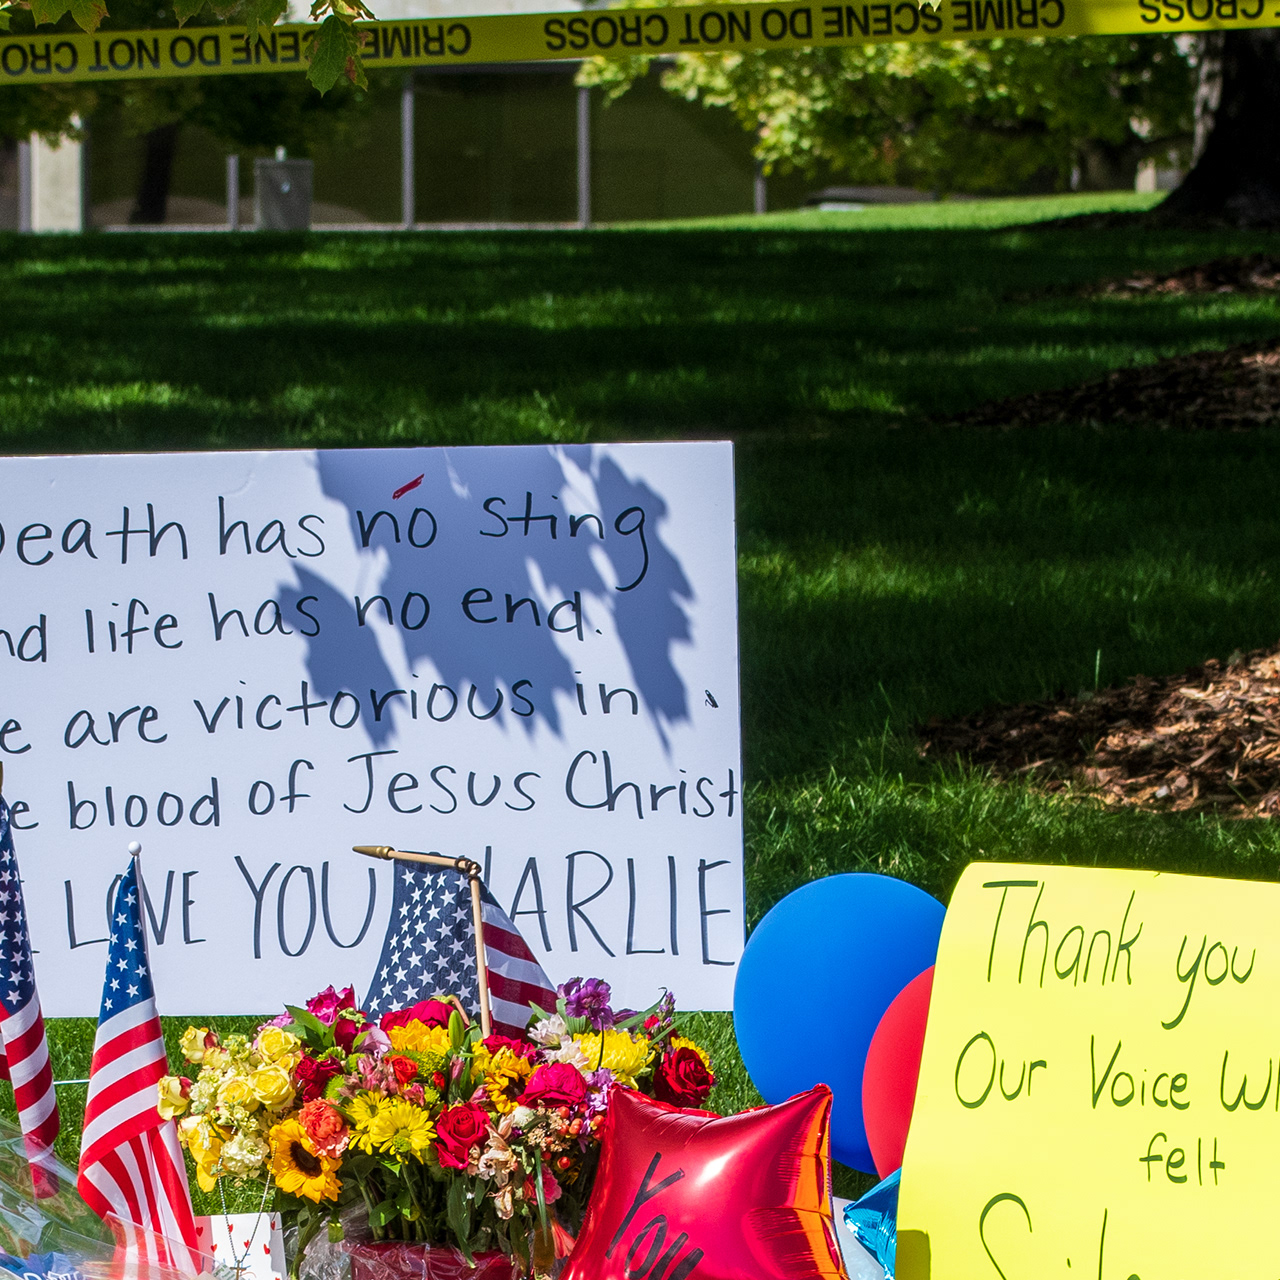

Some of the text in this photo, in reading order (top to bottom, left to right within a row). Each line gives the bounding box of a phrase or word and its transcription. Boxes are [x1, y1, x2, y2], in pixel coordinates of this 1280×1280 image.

[88, 38, 161, 71] NOT
[170, 35, 221, 68] DO
[360, 23, 472, 59] CRIME
[544, 0, 1065, 50] CRIME SCENE DO NOT CROSS
[219, 495, 325, 560] has
[357, 503, 437, 550] no
[478, 491, 648, 592] sting
[86, 598, 184, 656] life
[212, 592, 320, 642] has
[355, 587, 431, 631] no
[461, 586, 603, 642] end.
[63, 705, 168, 749] are
[193, 671, 535, 735] victorious
[575, 670, 639, 718] in
[69, 775, 221, 830] blood
[248, 758, 315, 815] of
[342, 748, 541, 816] Jesus
[565, 748, 738, 820] Christ
[233, 855, 376, 960] YOU
[982, 880, 1144, 988] Thank
[1160, 932, 1257, 1031] you
[954, 1030, 1048, 1110] Our
[1089, 1034, 1192, 1112] Voice
[1138, 1131, 1227, 1187] felt
